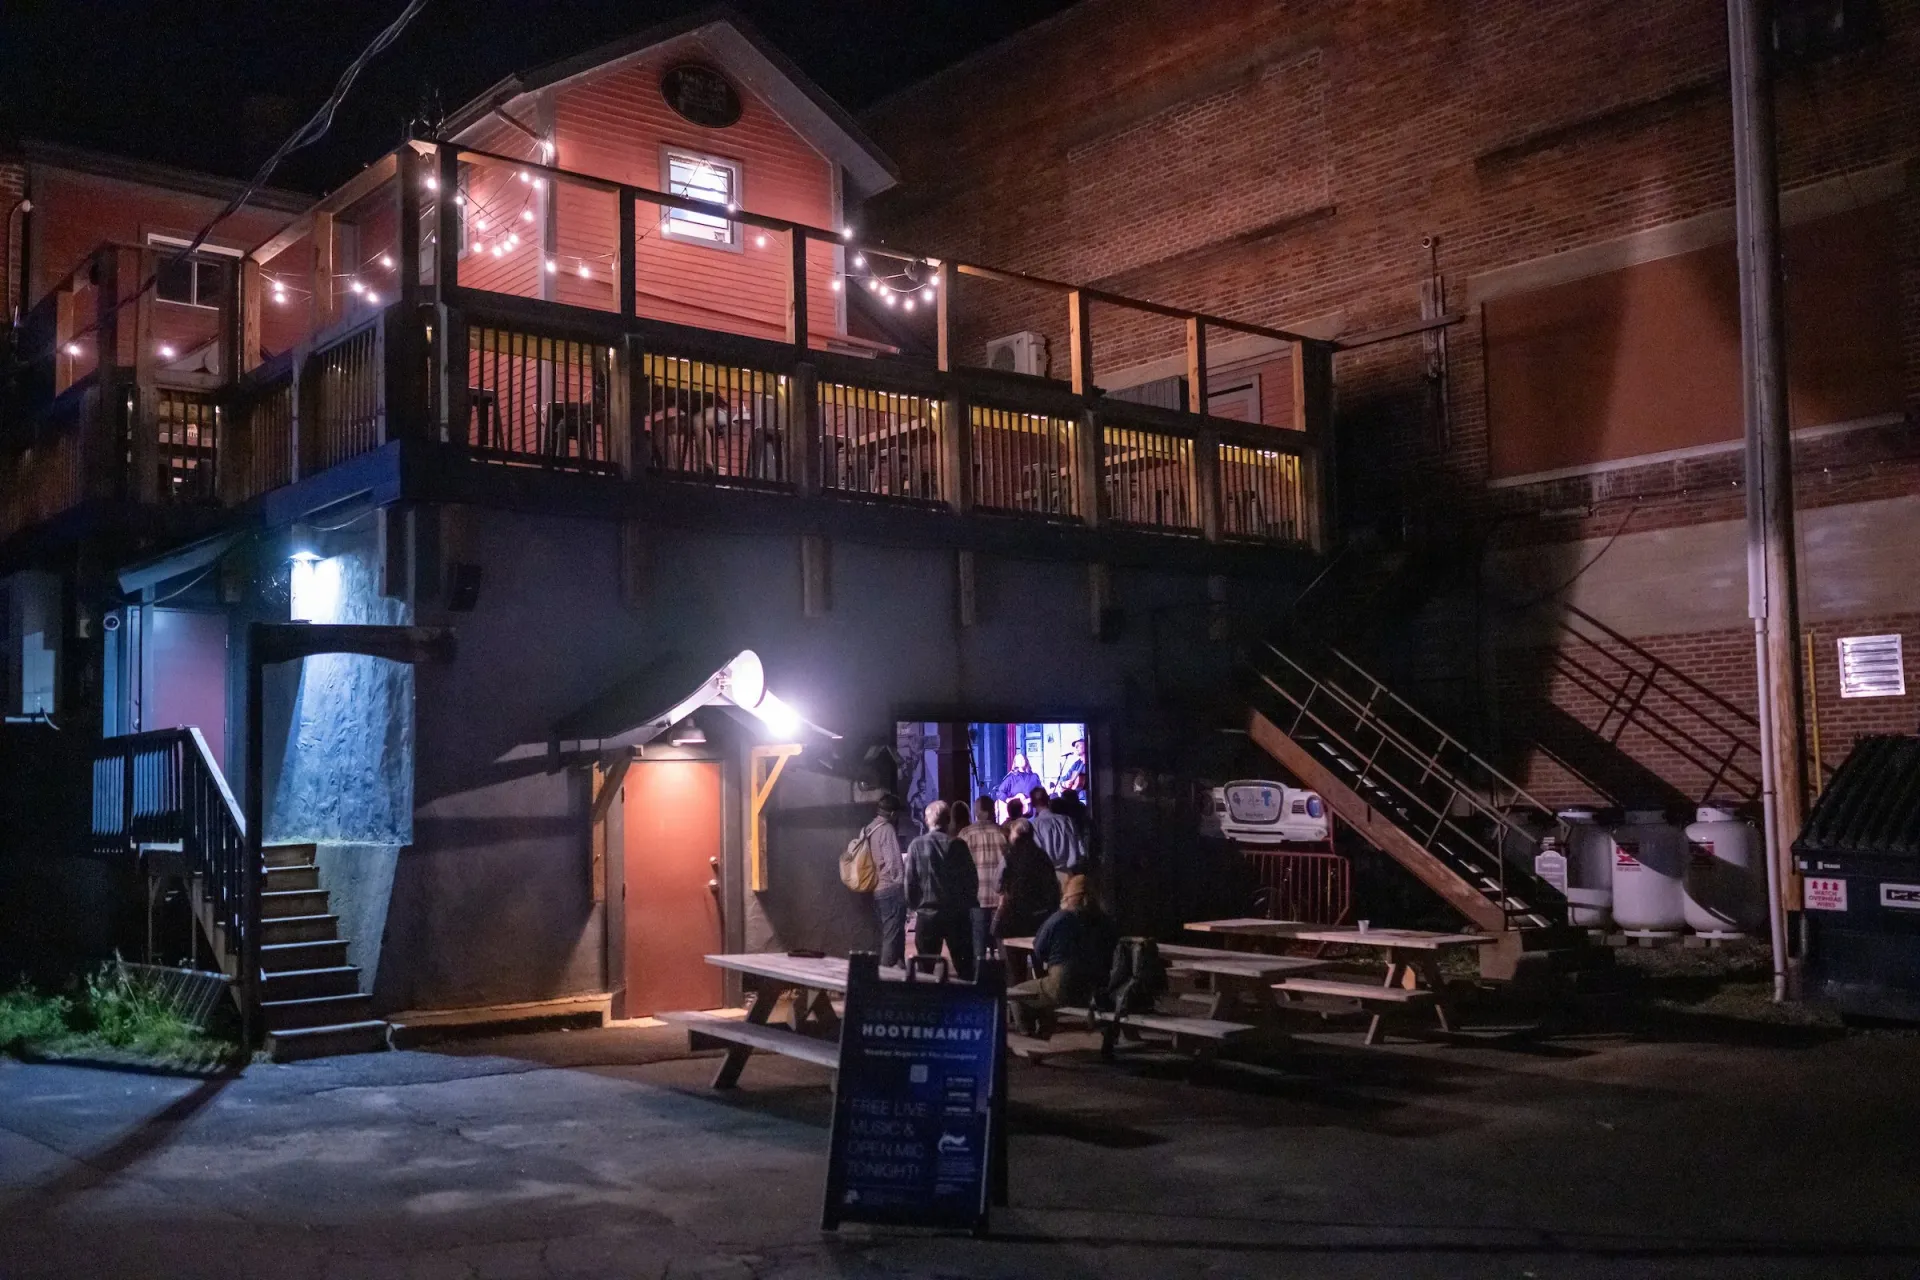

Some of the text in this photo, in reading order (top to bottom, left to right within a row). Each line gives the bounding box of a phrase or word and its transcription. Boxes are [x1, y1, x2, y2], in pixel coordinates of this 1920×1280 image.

[861, 1023, 984, 1041] HOOTENANNY
[851, 1098, 928, 1118] FREE LIVE
[850, 1119, 902, 1137] MUSIC
[847, 1140, 925, 1160] OPEN MIC
